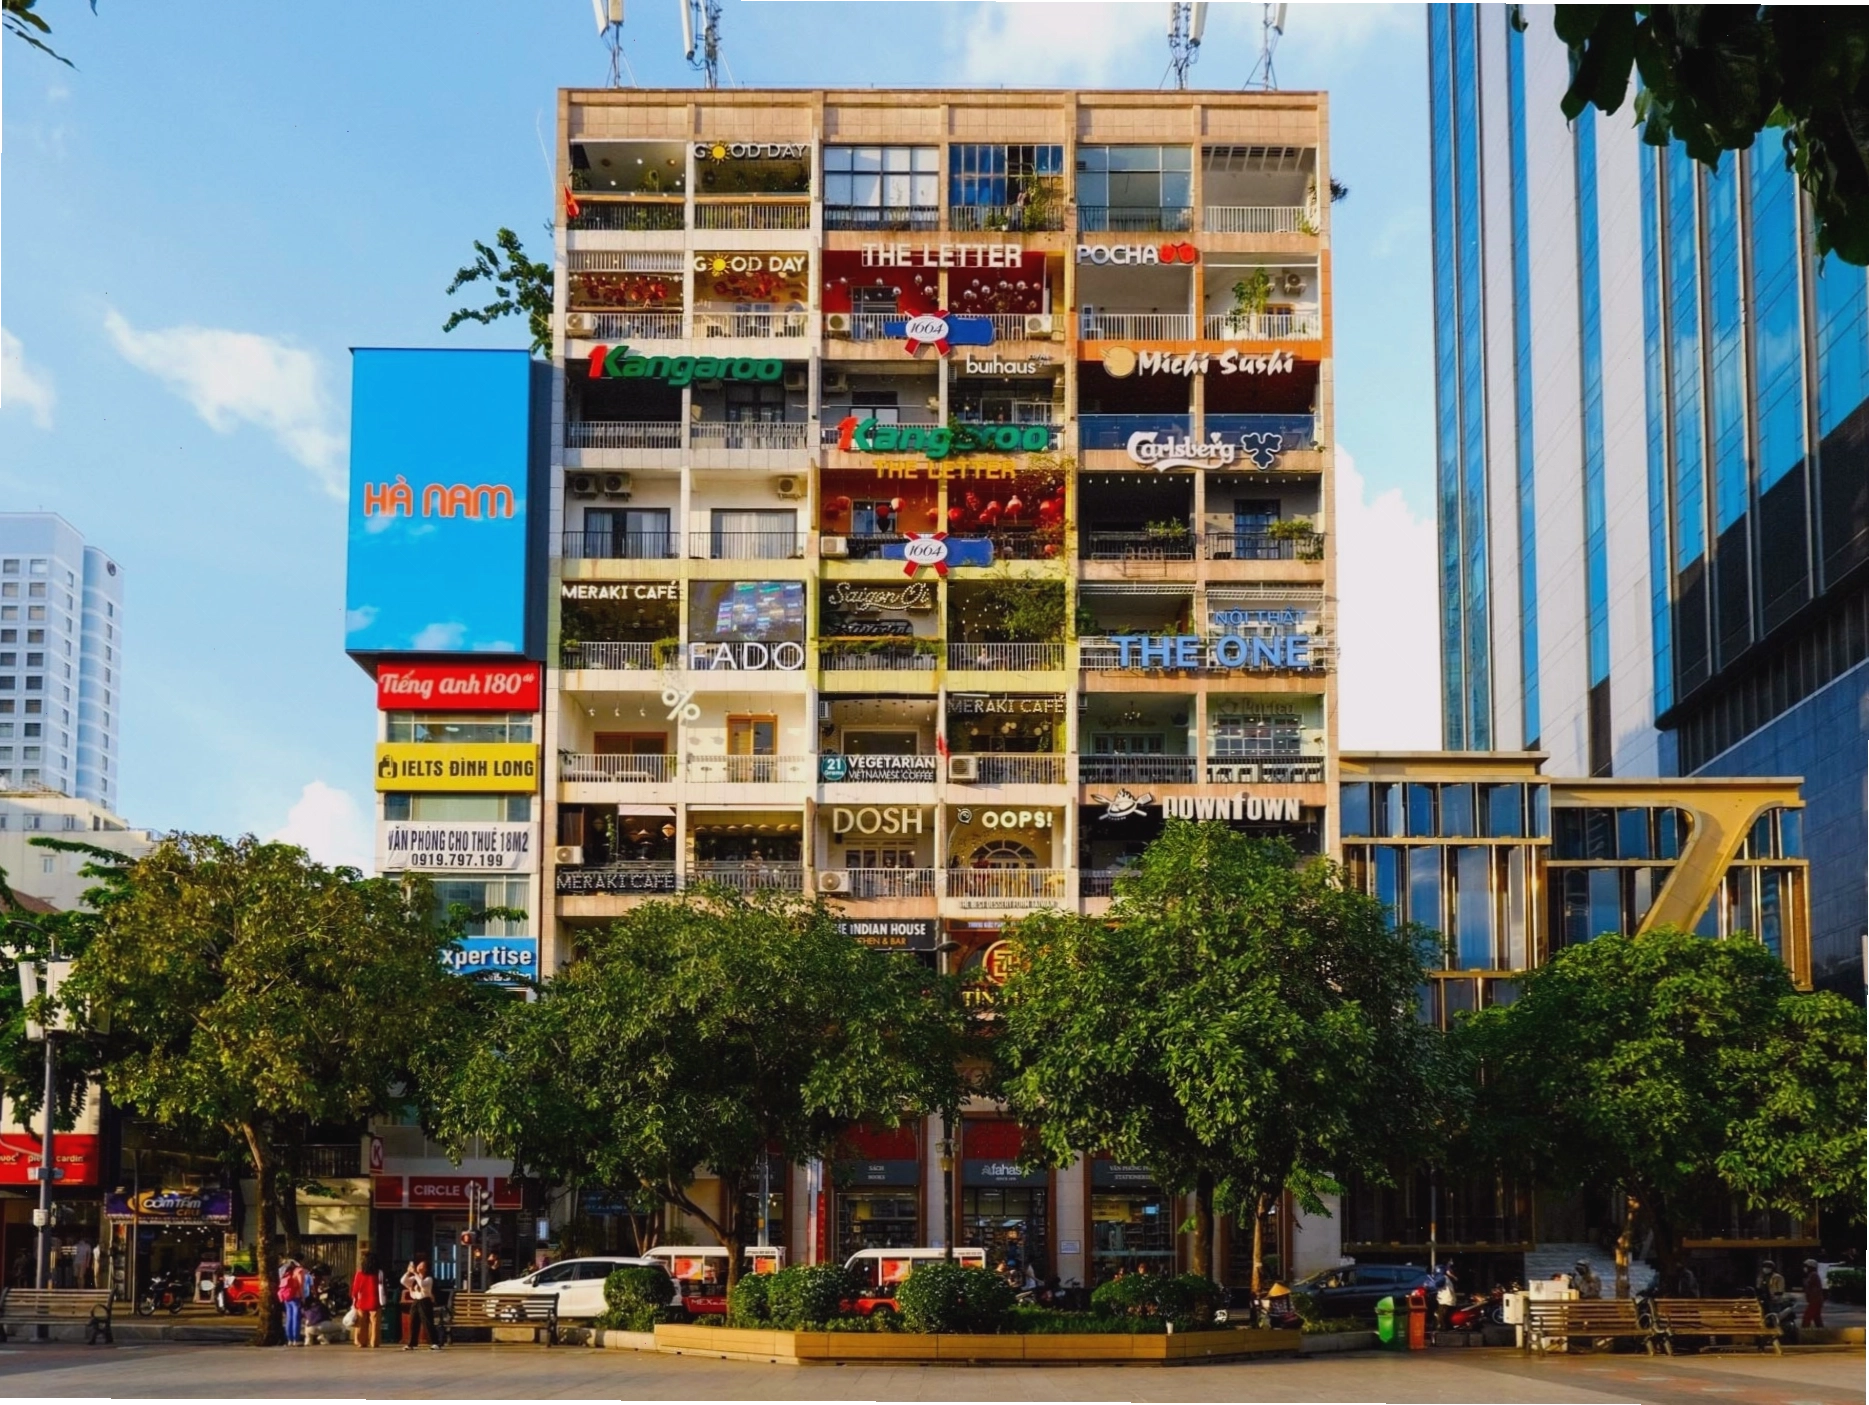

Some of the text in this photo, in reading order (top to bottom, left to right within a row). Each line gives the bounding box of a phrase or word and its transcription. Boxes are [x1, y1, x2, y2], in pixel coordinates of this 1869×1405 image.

[694, 140, 808, 165] GOOD DAY
[693, 252, 805, 276] GOOD DAY
[865, 243, 1022, 267] THE LETTER
[1077, 244, 1159, 264] POCHA
[909, 322, 945, 335] 1664
[1138, 348, 1294, 377] Michi Sushi
[1126, 431, 1236, 472] Carlsberg
[872, 459, 1017, 479] THE LETTER
[364, 474, 413, 517] HÀ
[909, 545, 944, 557] 1664
[562, 580, 679, 600] MERAKI CAFÉ
[690, 642, 805, 670] FADO
[1111, 634, 1310, 668] THE ONE
[380, 670, 434, 700] Tiếng
[438, 674, 480, 695] anh
[484, 673, 522, 694] 180
[947, 695, 1065, 713] MERAKI CAFÉ
[402, 757, 534, 777] IELTS ĐÌNH LONG
[827, 755, 936, 770] 21 VEGETARIAN
[901, 769, 935, 780] COFFEE
[833, 807, 923, 834] DOSH
[981, 811, 1053, 828] OOPS!
[388, 825, 409, 851] VĂN
[448, 830, 469, 852] CHO
[500, 831, 529, 852] 18M2
[411, 853, 503, 867] 0919.797.199
[556, 870, 675, 889] MERAKI CAFÉ
[850, 923, 888, 935] INDIAN
[890, 923, 926, 935] HOUSE
[890, 937, 906, 945] BAR
[441, 946, 532, 970] xpertise
[56, 1154, 84, 1162] cardin
[413, 1185, 460, 1196] CIRCLE
